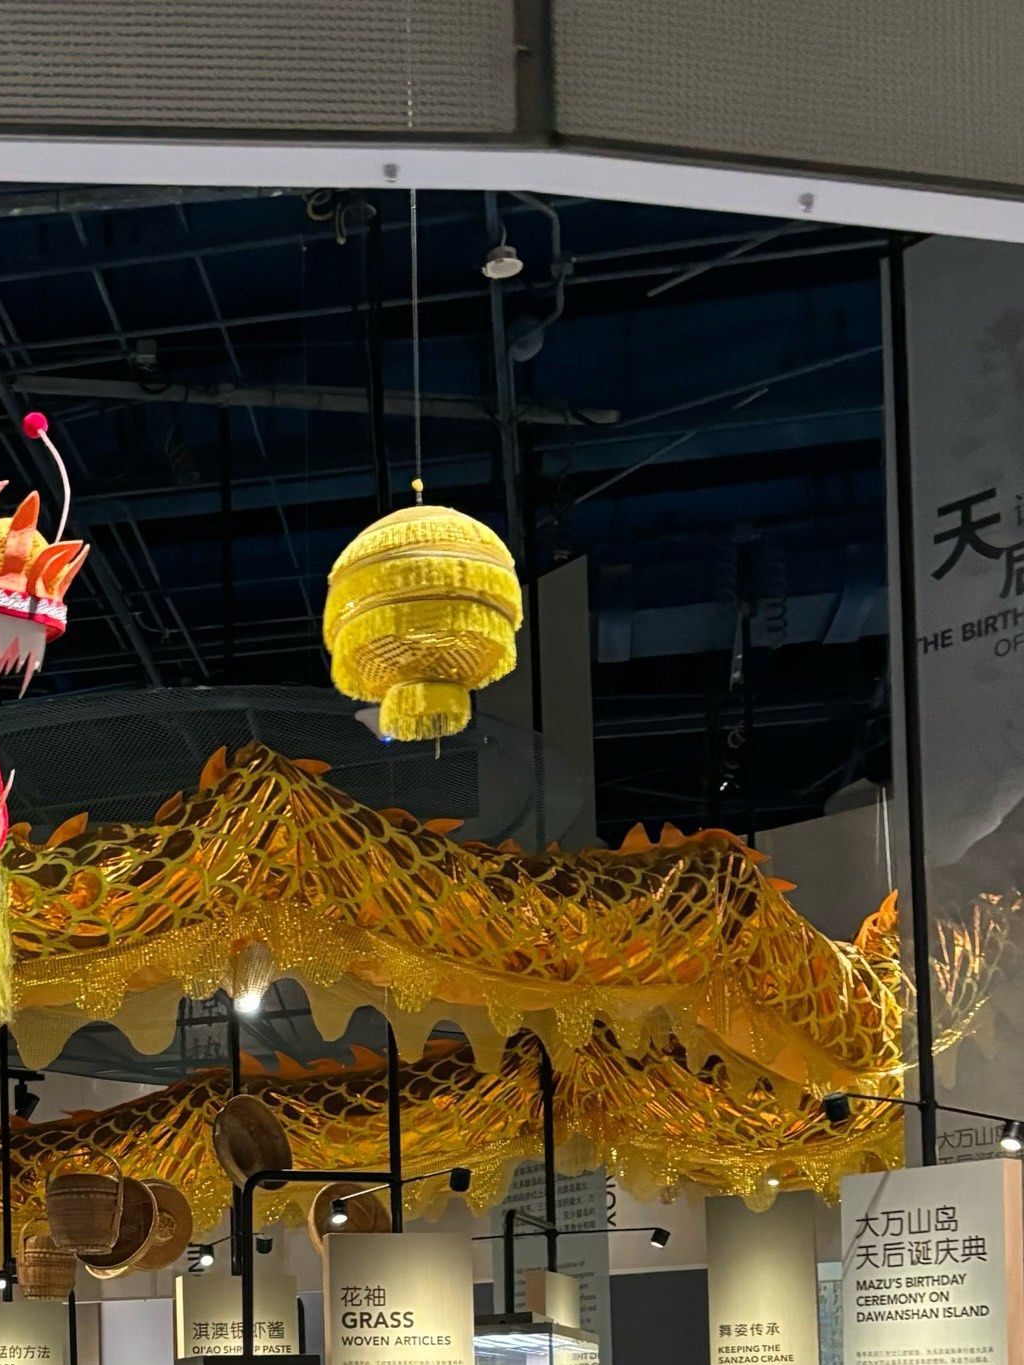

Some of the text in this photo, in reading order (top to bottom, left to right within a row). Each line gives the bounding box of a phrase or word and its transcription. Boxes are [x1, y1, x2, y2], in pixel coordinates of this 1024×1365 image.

[855, 1204, 959, 1239] 大万山岛
[855, 1235, 989, 1271] 天后诞庆典
[856, 1273, 967, 1291] MAZU'S BIRTHDAY
[341, 1285, 387, 1307] 花袖
[856, 1291, 950, 1307] CEREMONY ON
[341, 1311, 415, 1329] GRASS
[856, 1305, 990, 1323] DAWANSHAN ISLAND
[718, 1322, 781, 1338] 舞姿传承
[342, 1335, 452, 1346] WOVEN ARTICLES
[718, 1344, 781, 1354] KEEPING THE
[223, 1345, 261, 1354] SHRP
[263, 1345, 292, 1353] PASTE
[718, 1354, 794, 1364] SANZAO CRANE
